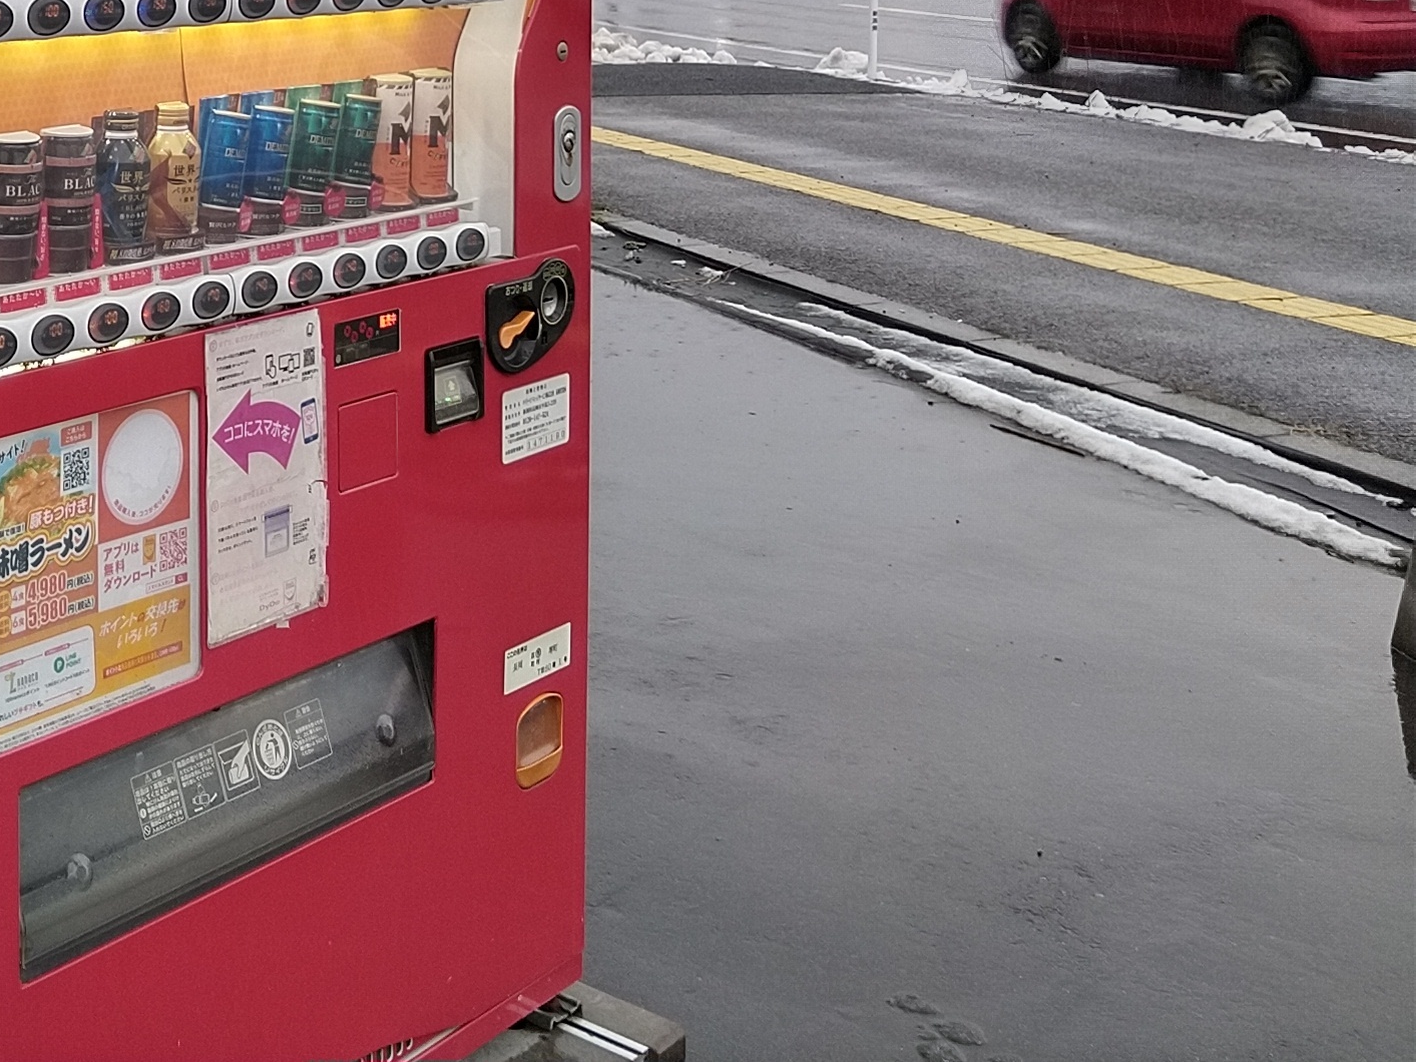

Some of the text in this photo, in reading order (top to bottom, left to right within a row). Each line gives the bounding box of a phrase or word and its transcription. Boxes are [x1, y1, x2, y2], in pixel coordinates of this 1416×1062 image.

[224, 419, 295, 444] ココにスマホを!
[103, 541, 139, 562] アプリは
[104, 558, 125, 577] 無料
[104, 563, 158, 593] ダウンロード
[27, 571, 67, 603] 4,980
[27, 597, 68, 629] 5,980
